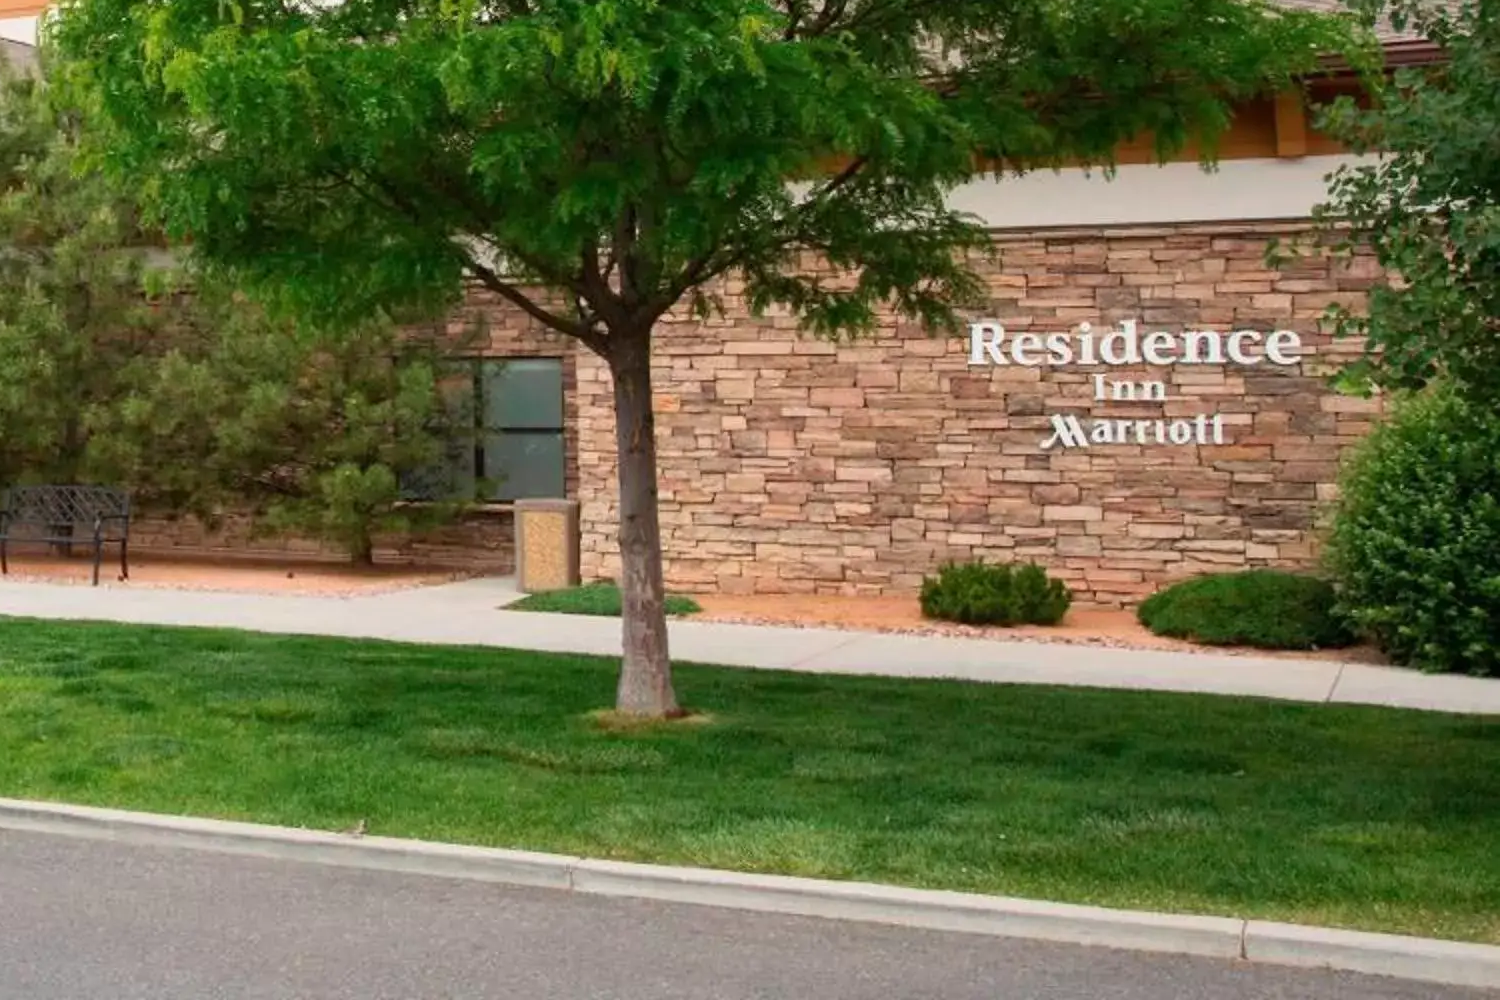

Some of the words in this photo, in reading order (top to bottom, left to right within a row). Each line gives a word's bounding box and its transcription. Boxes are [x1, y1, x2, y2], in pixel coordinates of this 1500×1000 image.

[967, 319, 1302, 366] Residence
[1092, 373, 1166, 402] Inn
[1039, 413, 1224, 450] Marriott
